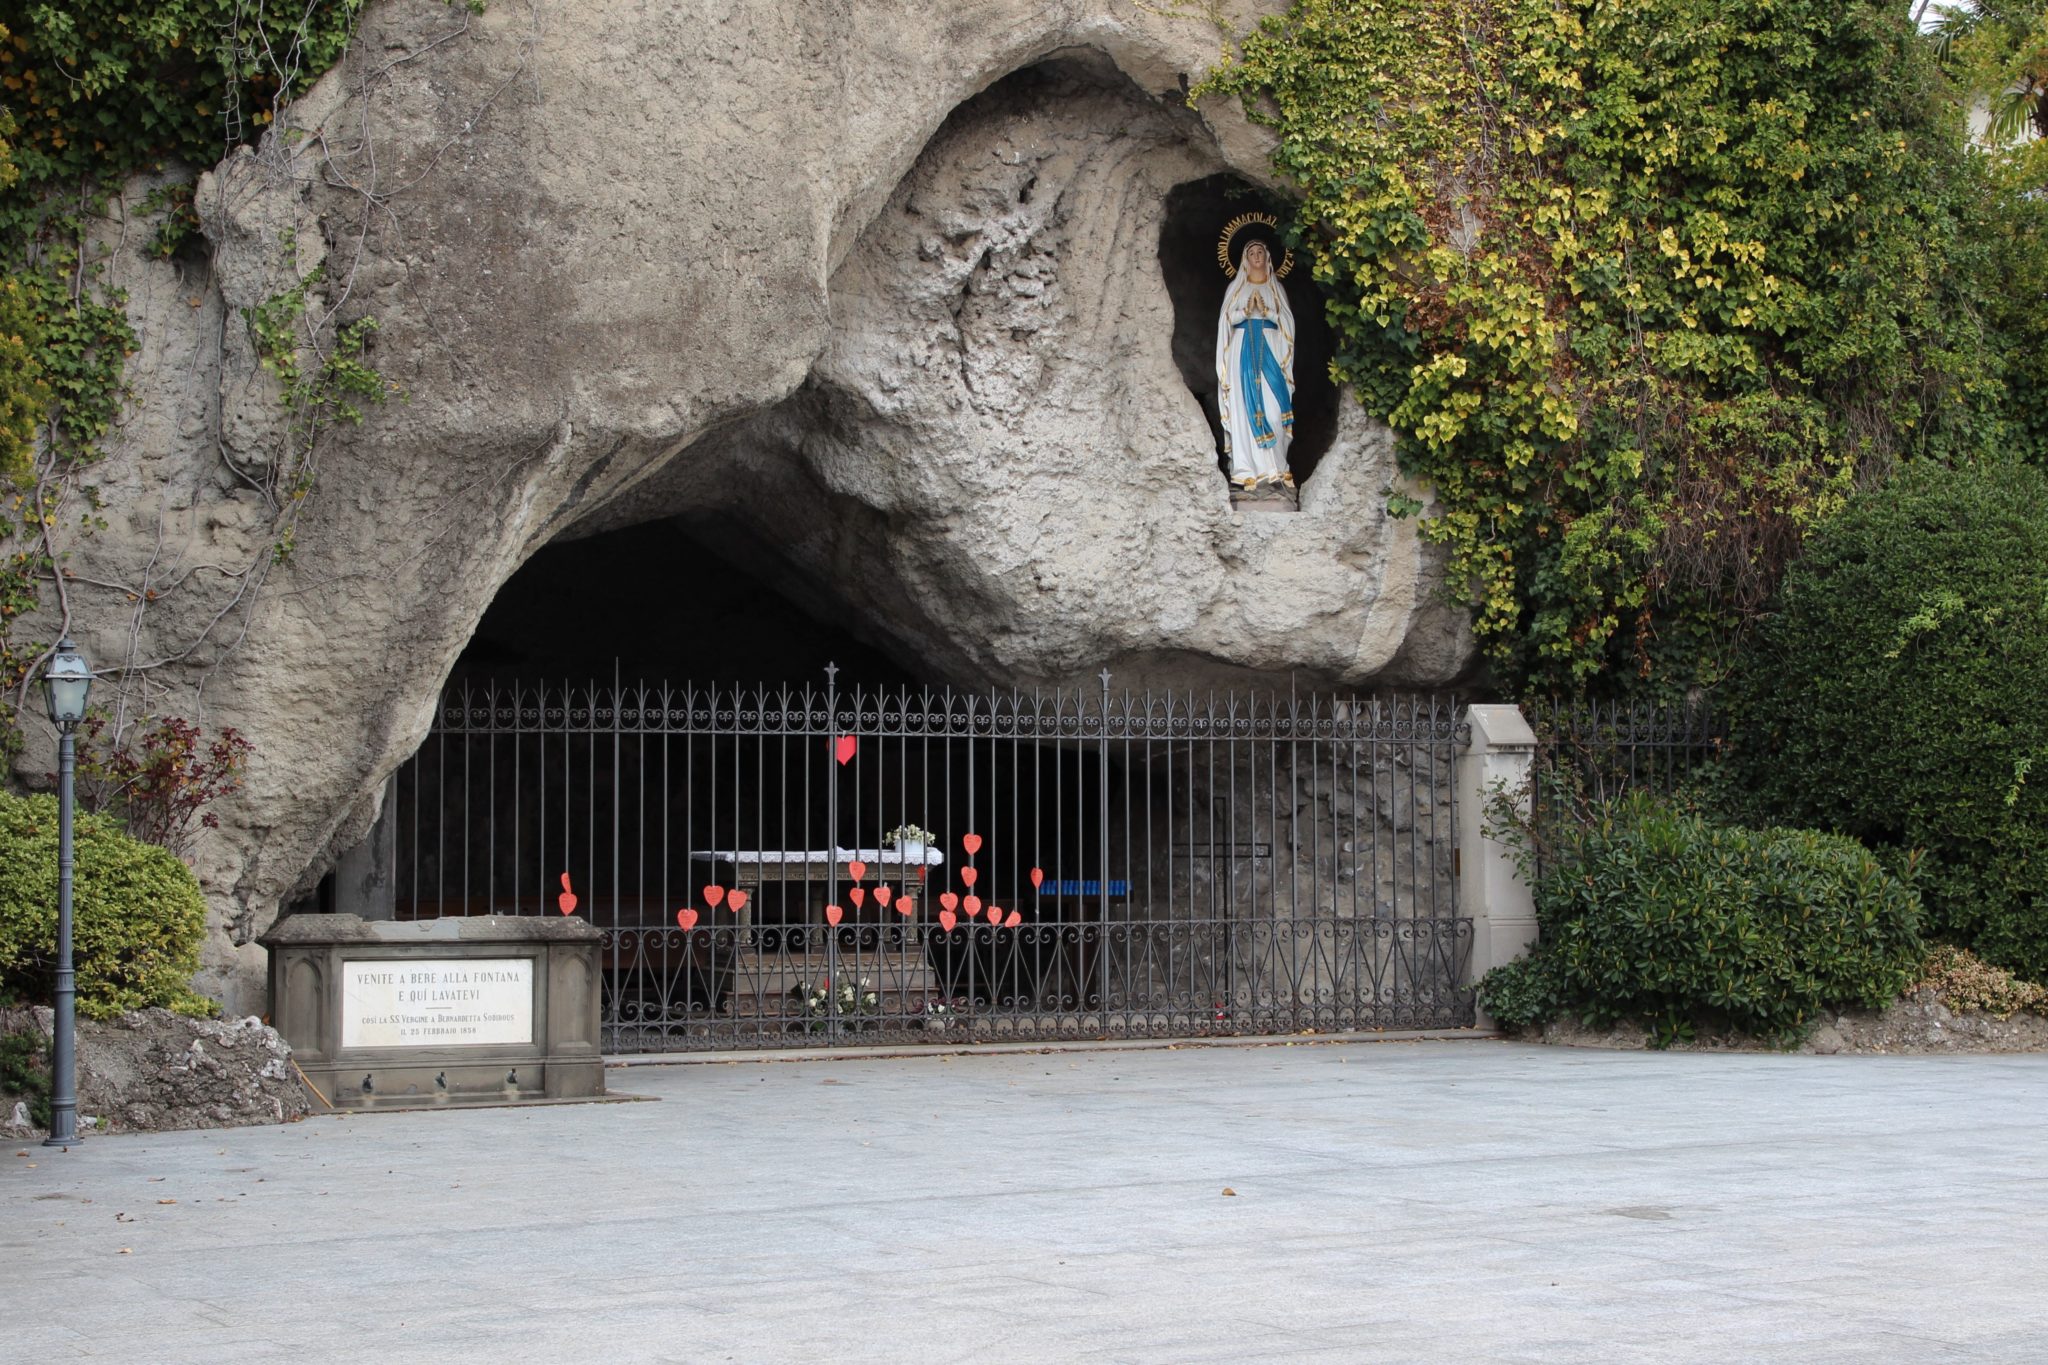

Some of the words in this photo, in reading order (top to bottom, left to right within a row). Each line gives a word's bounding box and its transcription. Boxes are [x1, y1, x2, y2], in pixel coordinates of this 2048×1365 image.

[1217, 242, 1229, 268] SONO
[357, 974, 394, 985] VENITE
[399, 974, 405, 984] A
[411, 973, 436, 984] BERE
[443, 972, 468, 983] ALLA
[474, 971, 519, 983] FONTANA
[399, 990, 405, 1001] E
[432, 989, 480, 1001] LAVATEVI
[401, 1014, 428, 1024] VERGINE
[438, 1013, 481, 1023] BERNARDETTA
[400, 1028, 407, 1036] IL
[411, 1028, 420, 1036] 25
[423, 1027, 457, 1036] FEBBRAIO
[460, 1026, 477, 1036] 1858
